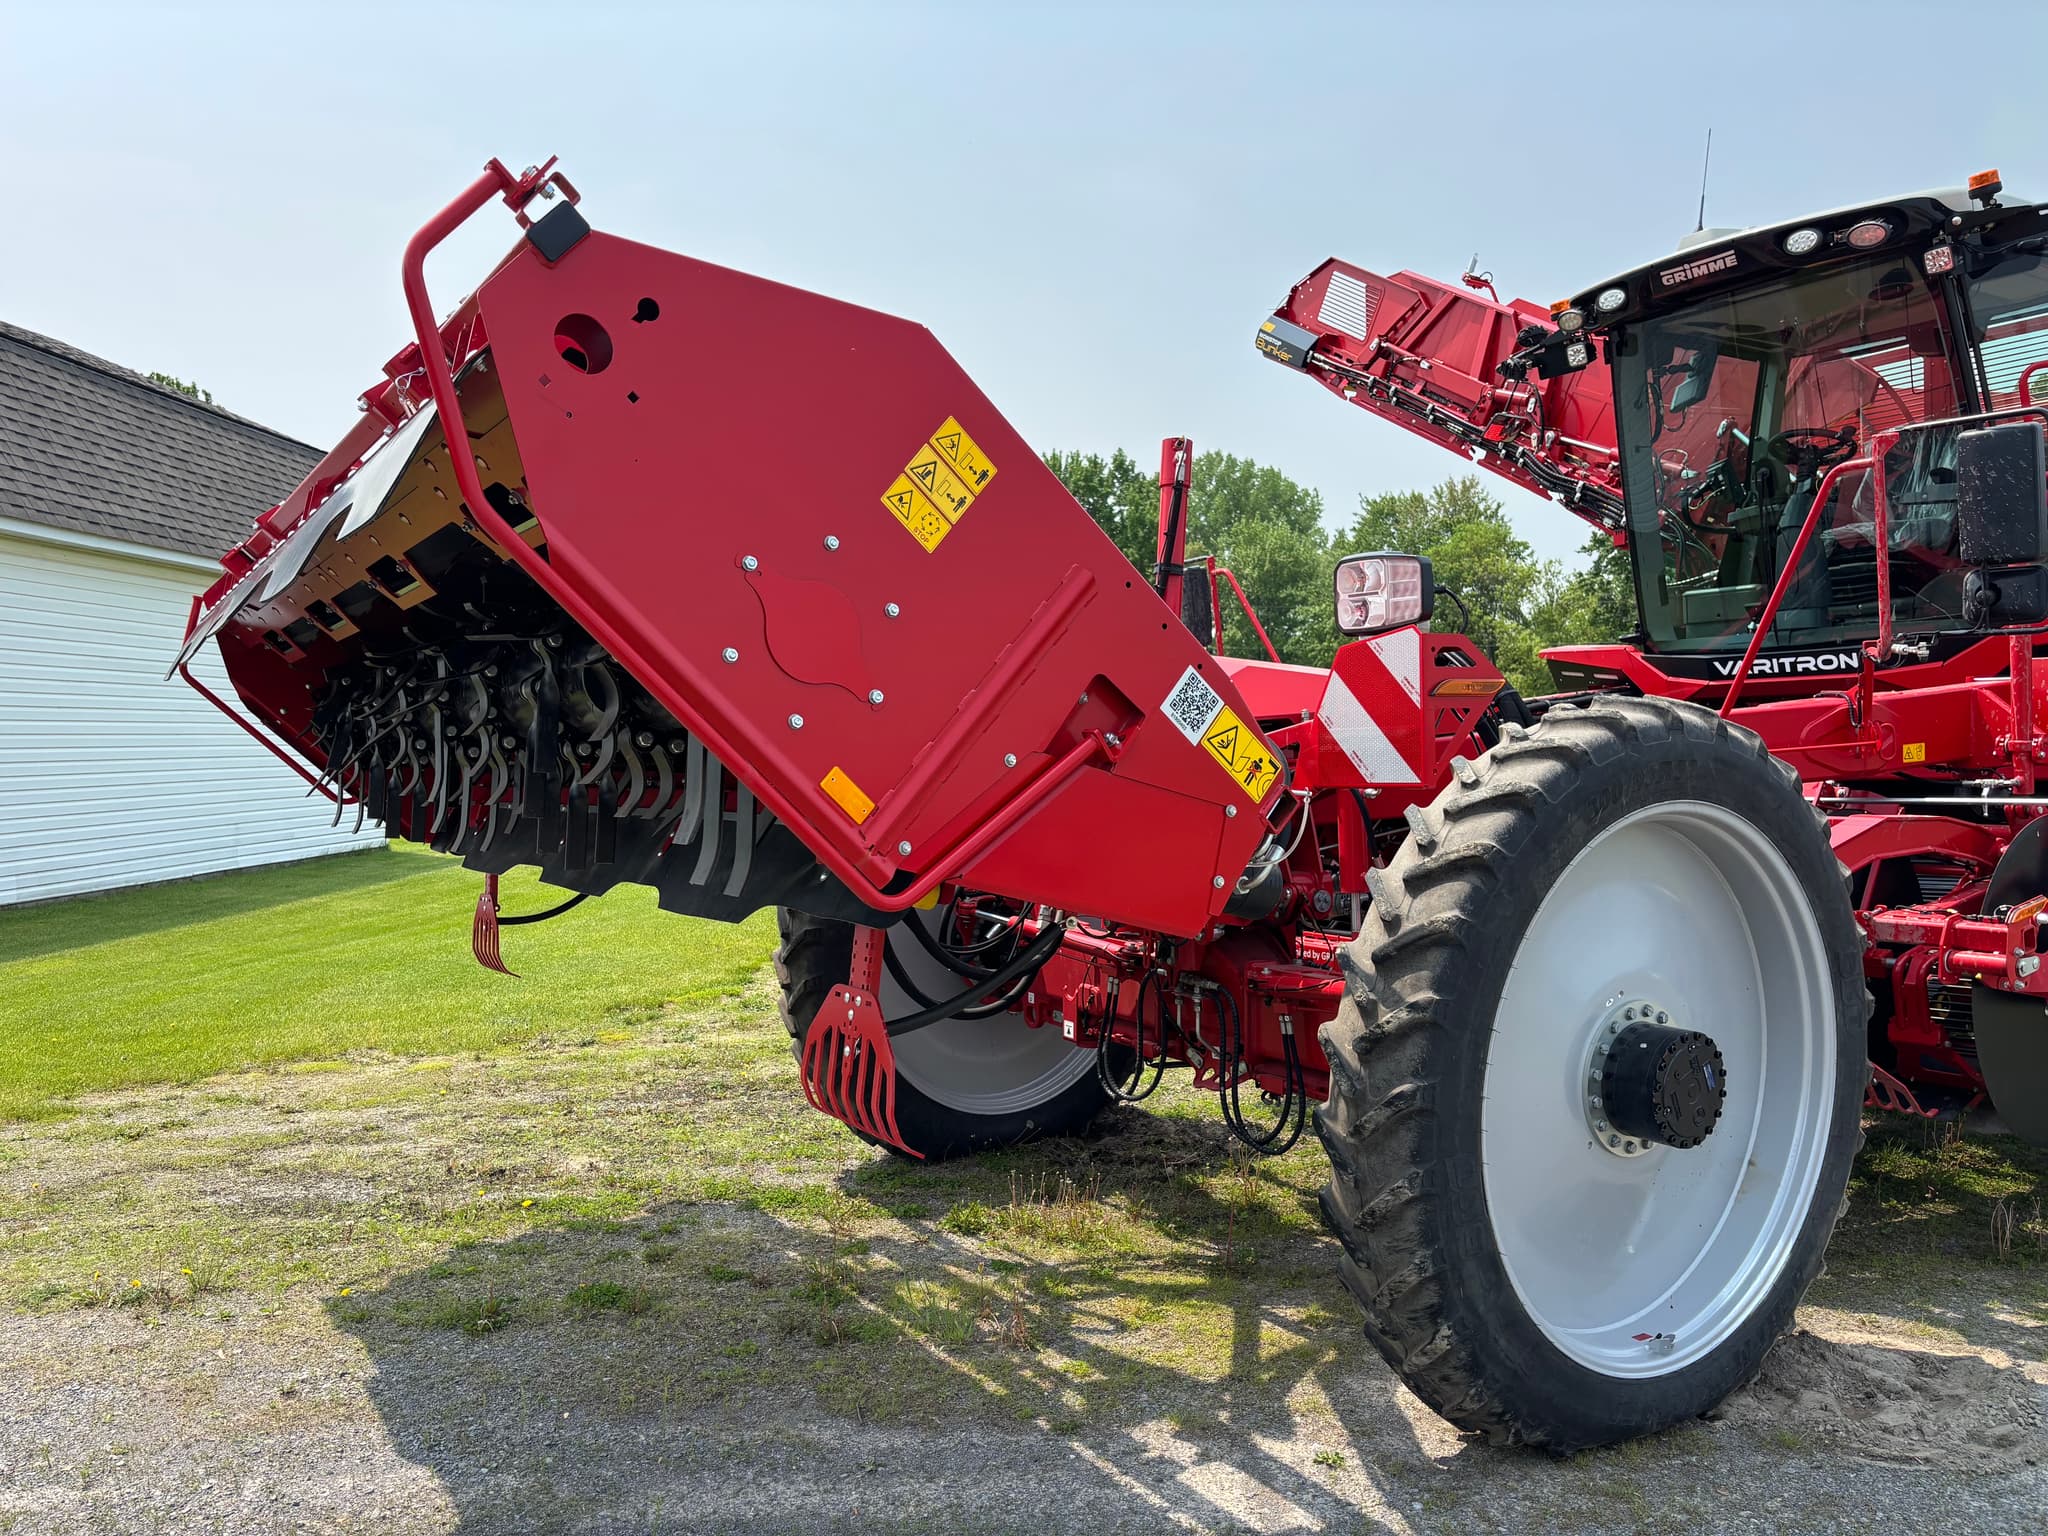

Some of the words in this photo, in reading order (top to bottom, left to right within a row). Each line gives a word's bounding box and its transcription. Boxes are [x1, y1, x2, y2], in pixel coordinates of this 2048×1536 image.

[1660, 250, 1738, 286] GRIMME
[1256, 337, 1293, 361] Bunker
[913, 526, 930, 543] STOP
[1713, 652, 1860, 676] VARITRON
